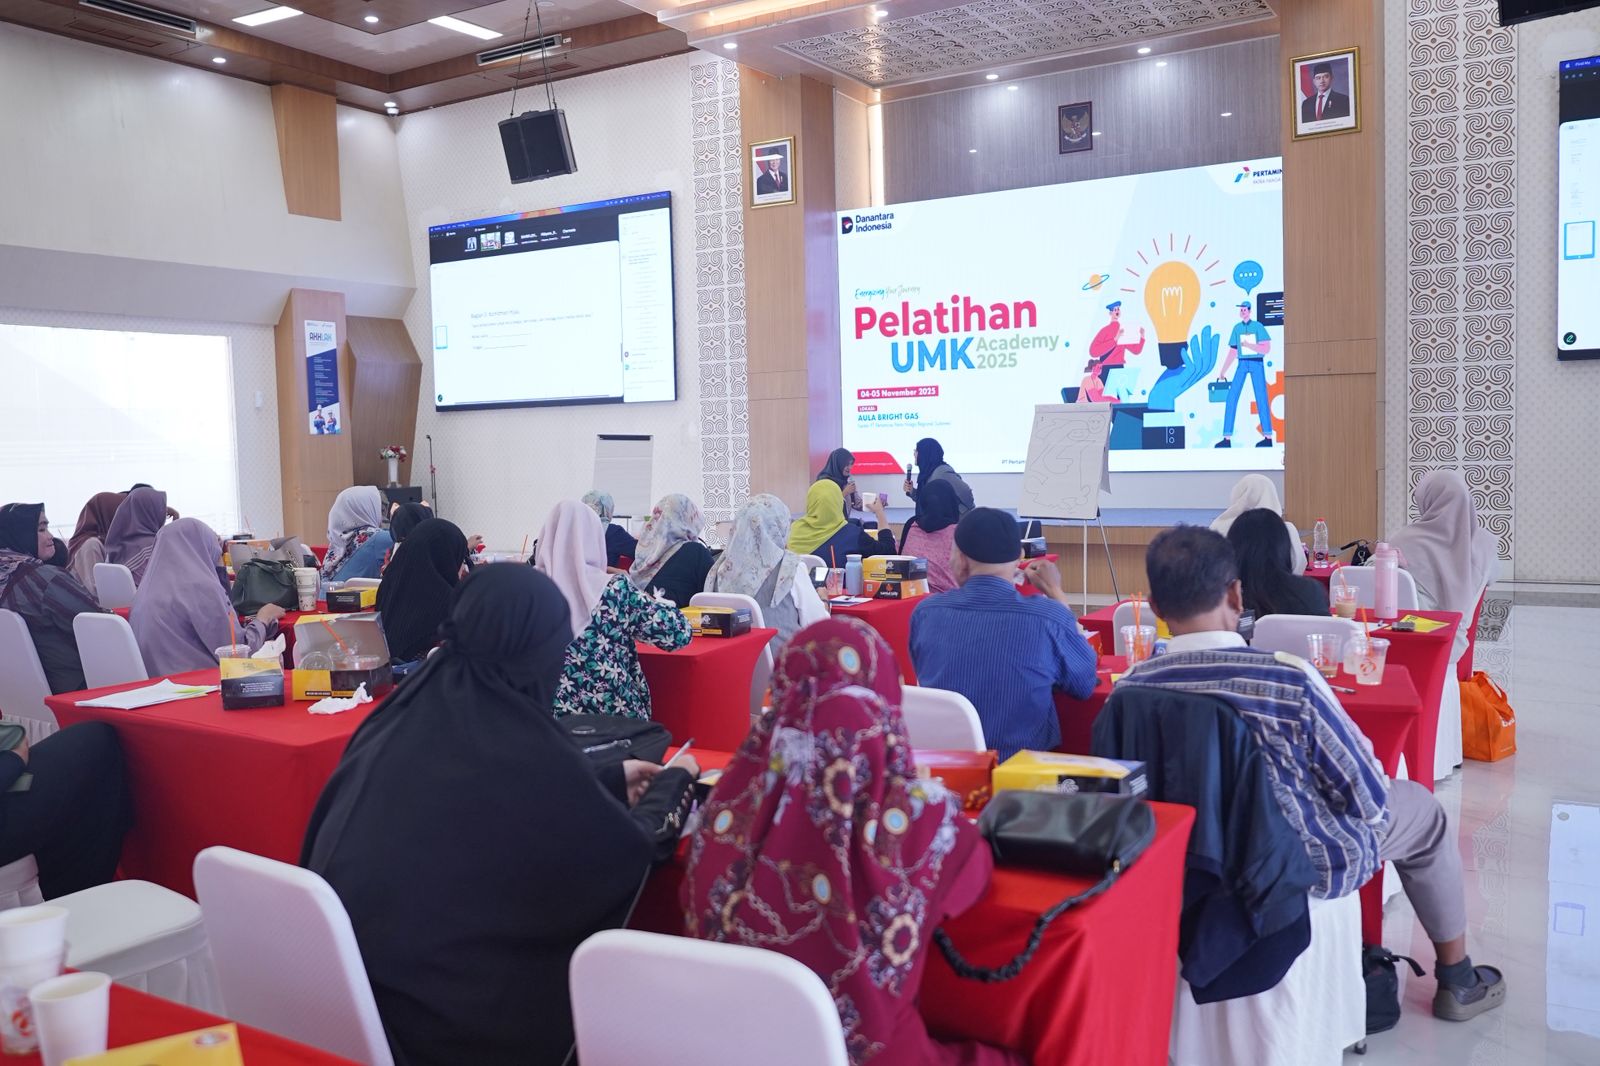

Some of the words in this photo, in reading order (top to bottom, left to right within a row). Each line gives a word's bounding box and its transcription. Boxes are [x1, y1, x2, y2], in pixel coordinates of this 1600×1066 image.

[855, 213, 894, 223] Danantara
[855, 221, 892, 232] Indonesia
[854, 294, 1037, 339] Pelatihan
[891, 337, 975, 373] UMK
[976, 333, 1059, 351] Academy
[976, 352, 1018, 369] 2025
[860, 390, 880, 398] 04-05
[881, 388, 917, 397] November
[918, 387, 936, 395] 2025
